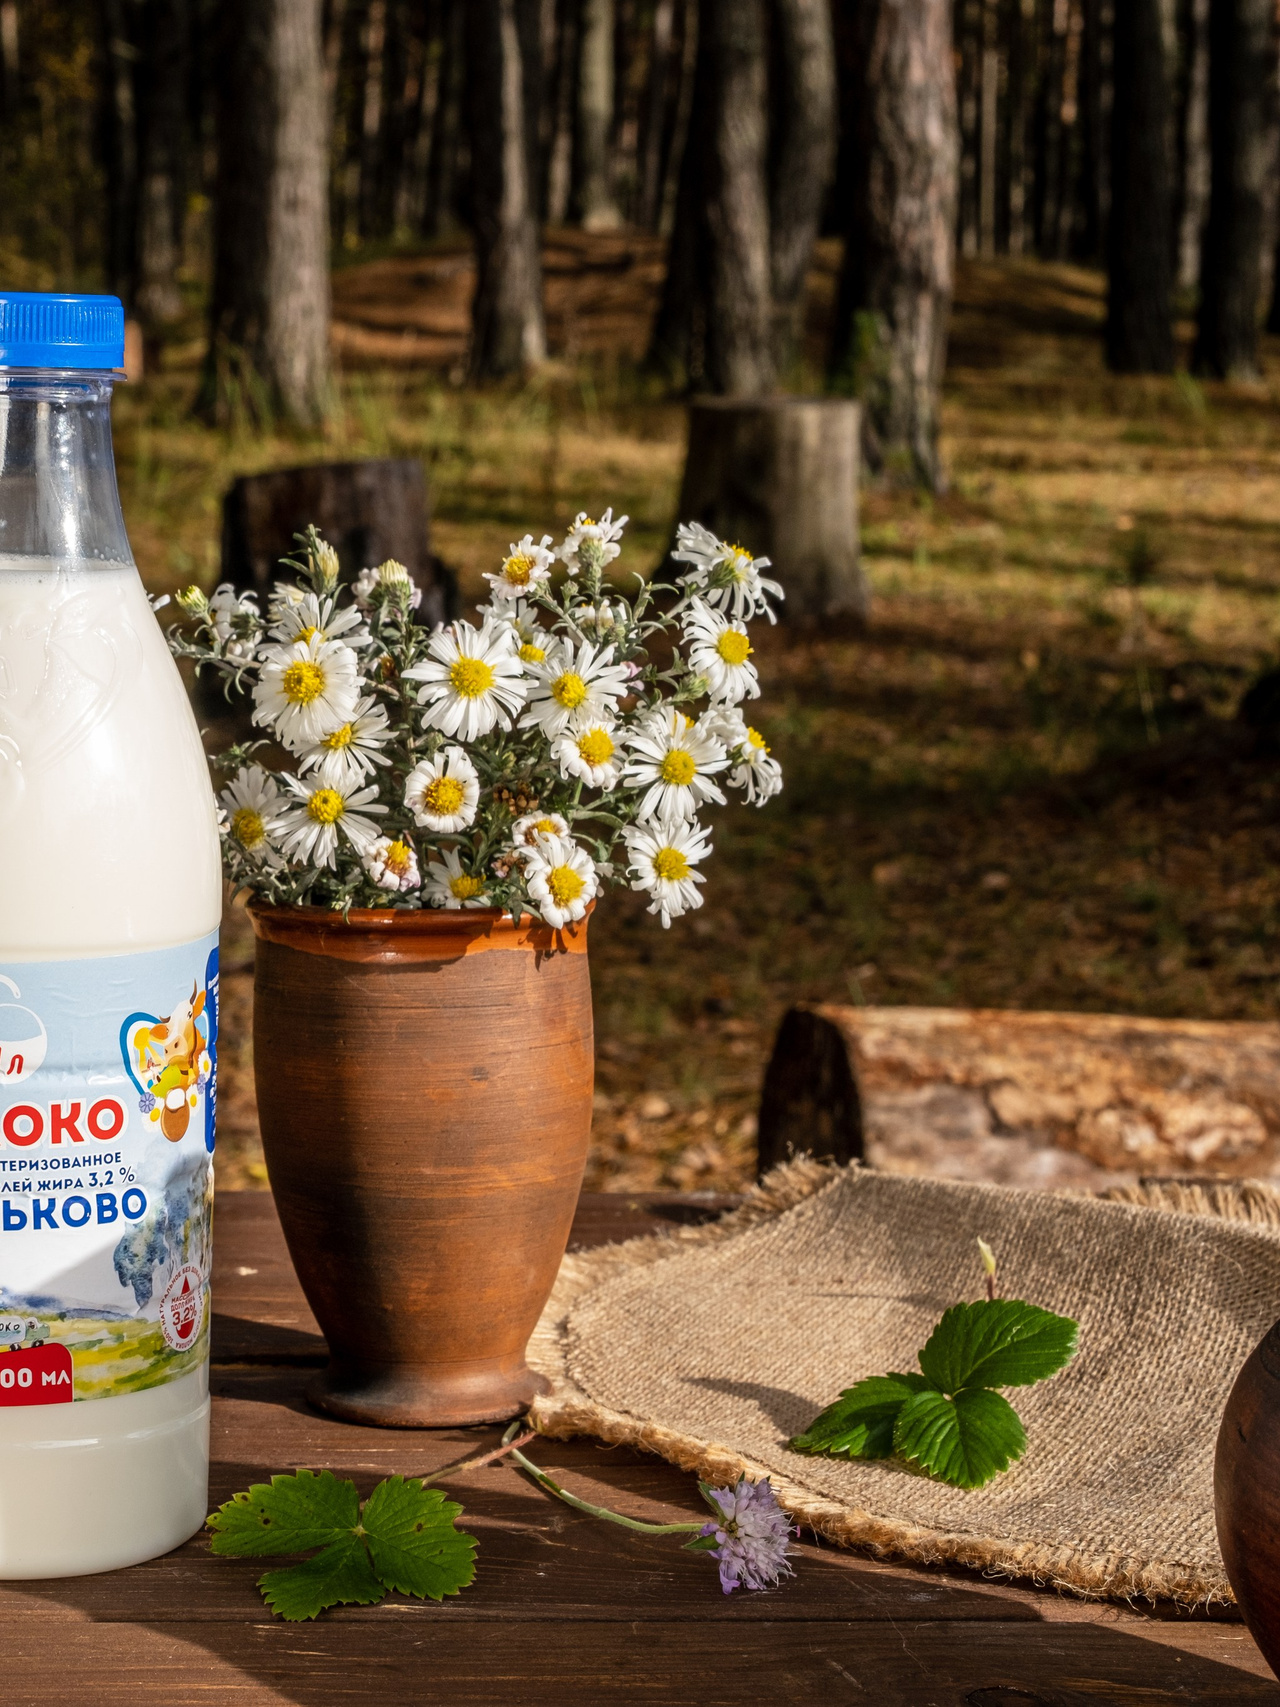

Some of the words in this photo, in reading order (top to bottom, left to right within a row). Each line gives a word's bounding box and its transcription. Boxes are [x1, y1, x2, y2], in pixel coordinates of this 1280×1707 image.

[37, 1178, 84, 1191] ЖИРА
[88, 1170, 114, 1188] 3,2
[119, 1166, 135, 1183] %
[172, 1302, 197, 1326] 3.2%
